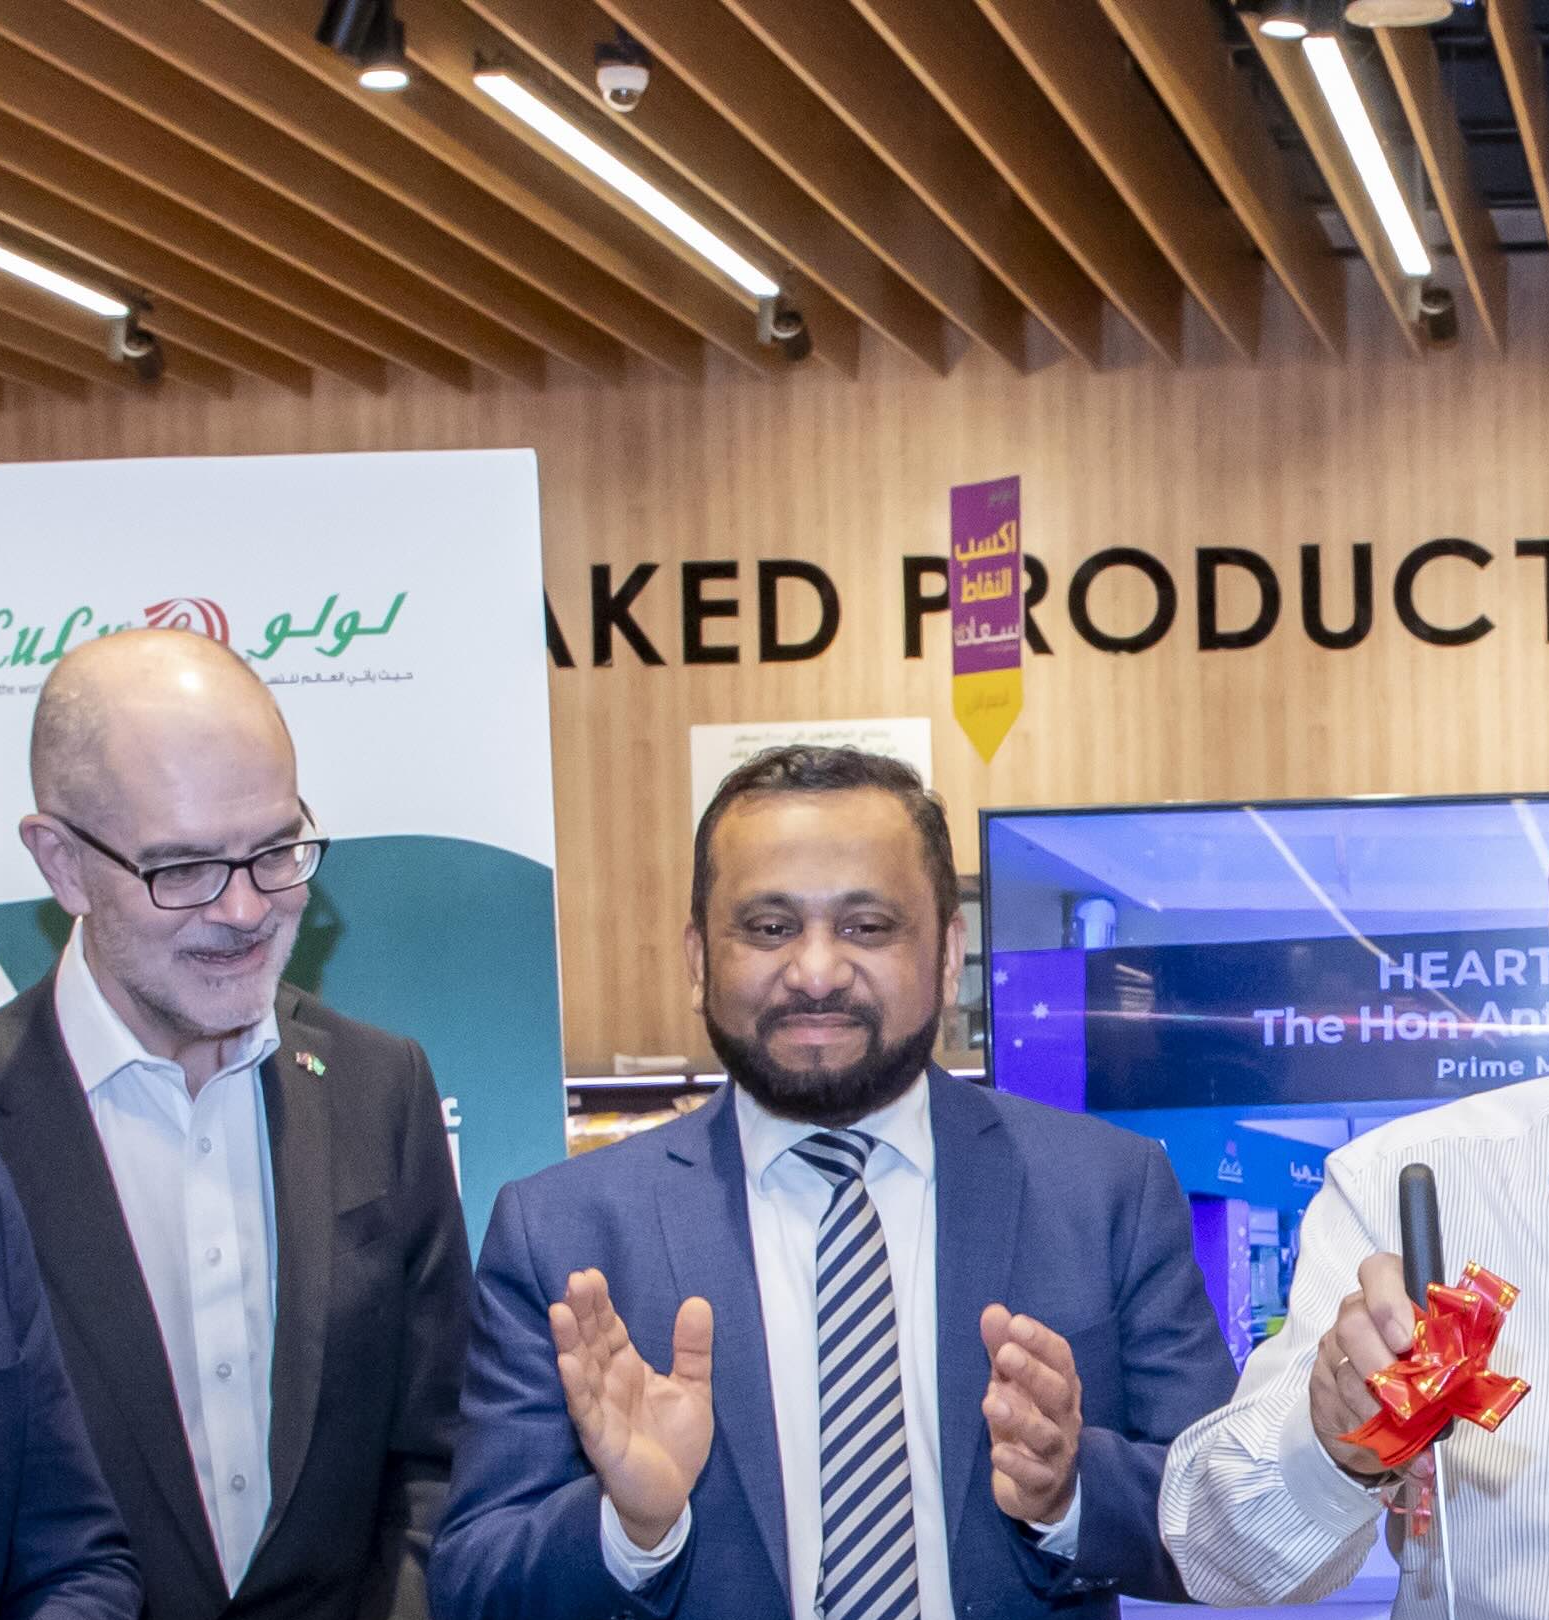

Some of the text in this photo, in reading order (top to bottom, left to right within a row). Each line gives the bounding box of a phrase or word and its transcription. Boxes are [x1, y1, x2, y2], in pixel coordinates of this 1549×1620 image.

[246, 592, 408, 661] لولو
[1254, 1007, 1345, 1046] The
[1359, 1004, 1458, 1043] Hon
[1437, 1056, 1524, 1079] Prime
